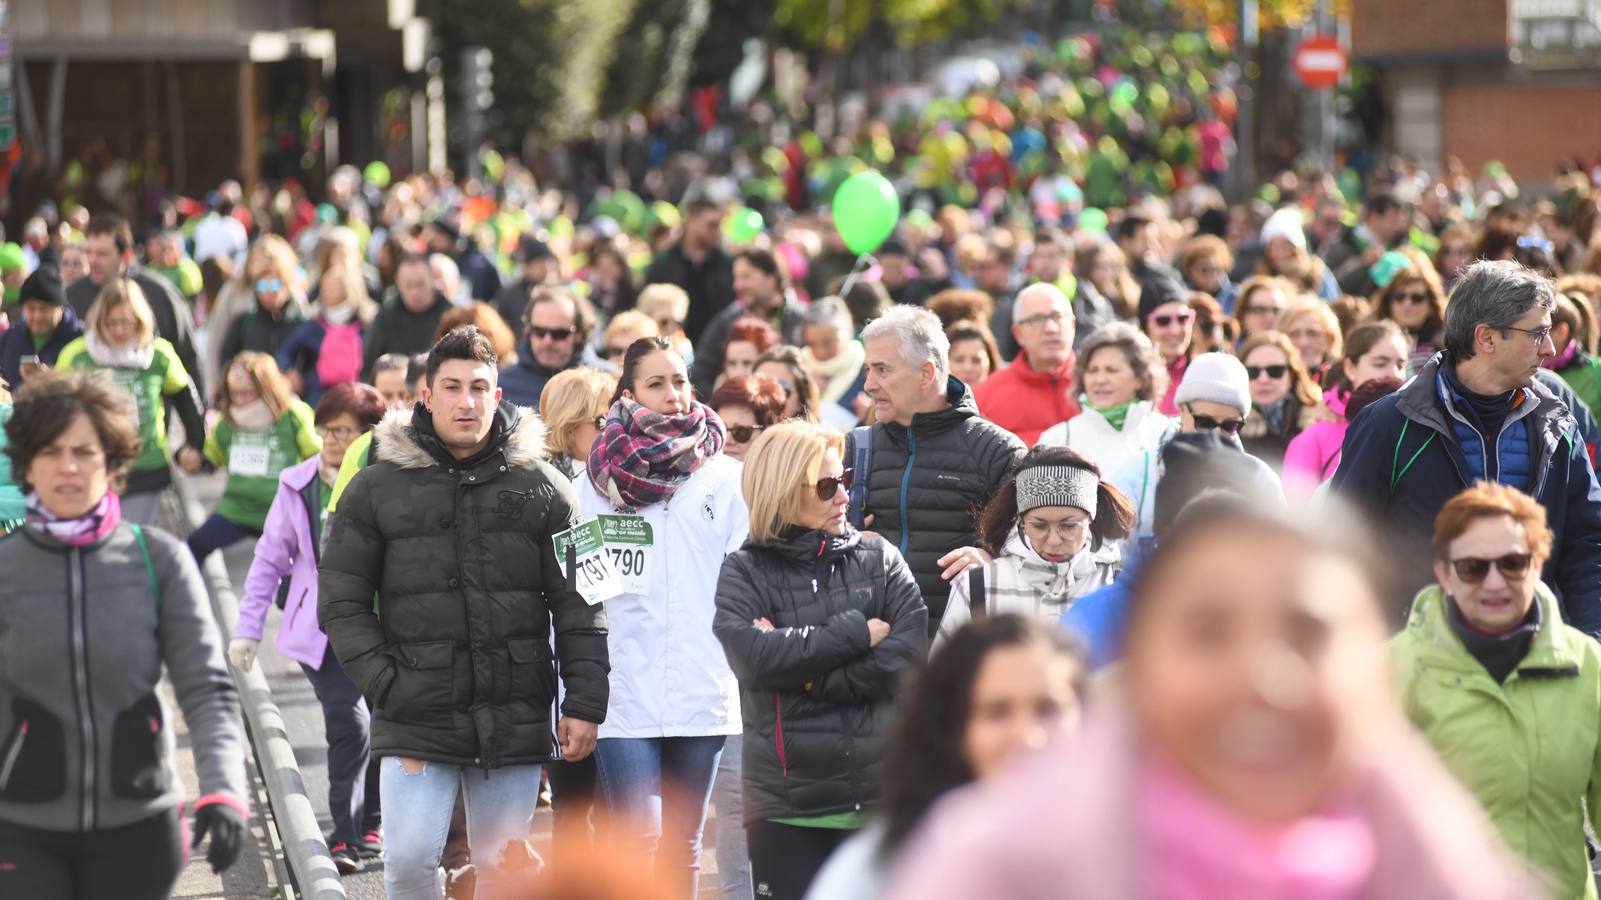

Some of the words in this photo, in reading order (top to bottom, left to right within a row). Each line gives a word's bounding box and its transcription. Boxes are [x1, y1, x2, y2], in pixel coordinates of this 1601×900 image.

[620, 519, 644, 528] aecc
[570, 526, 591, 541] aecc
[575, 553, 610, 588] 797
